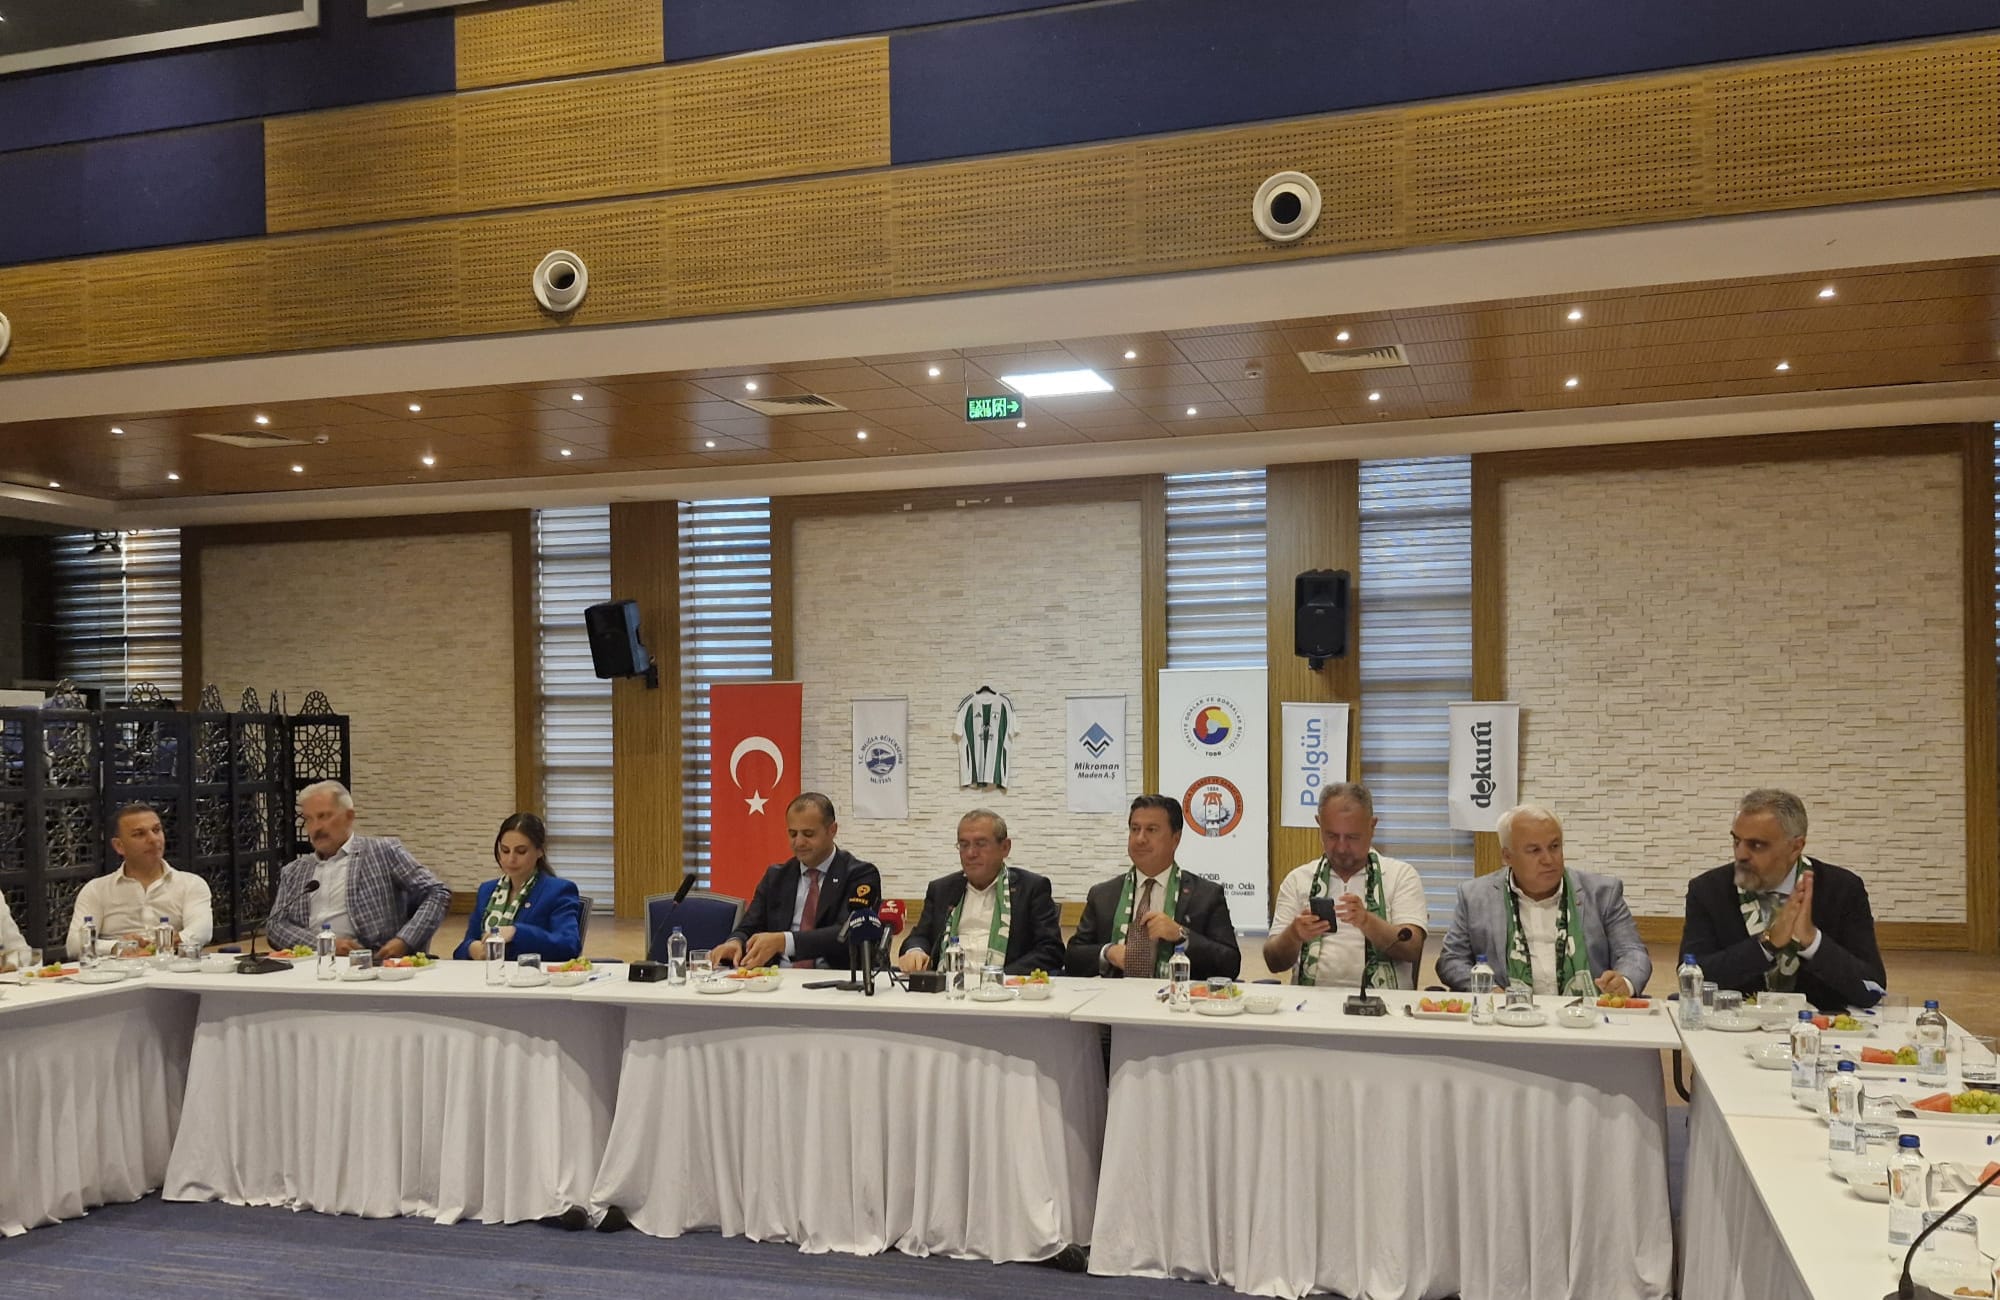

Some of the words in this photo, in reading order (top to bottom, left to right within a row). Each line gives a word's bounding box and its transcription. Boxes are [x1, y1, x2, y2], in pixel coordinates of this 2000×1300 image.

[969, 400, 991, 409] EXIT
[1074, 762, 1120, 770] Mikroman
[1300, 718, 1328, 806] Polgün
[1078, 770, 1103, 778] Maden
